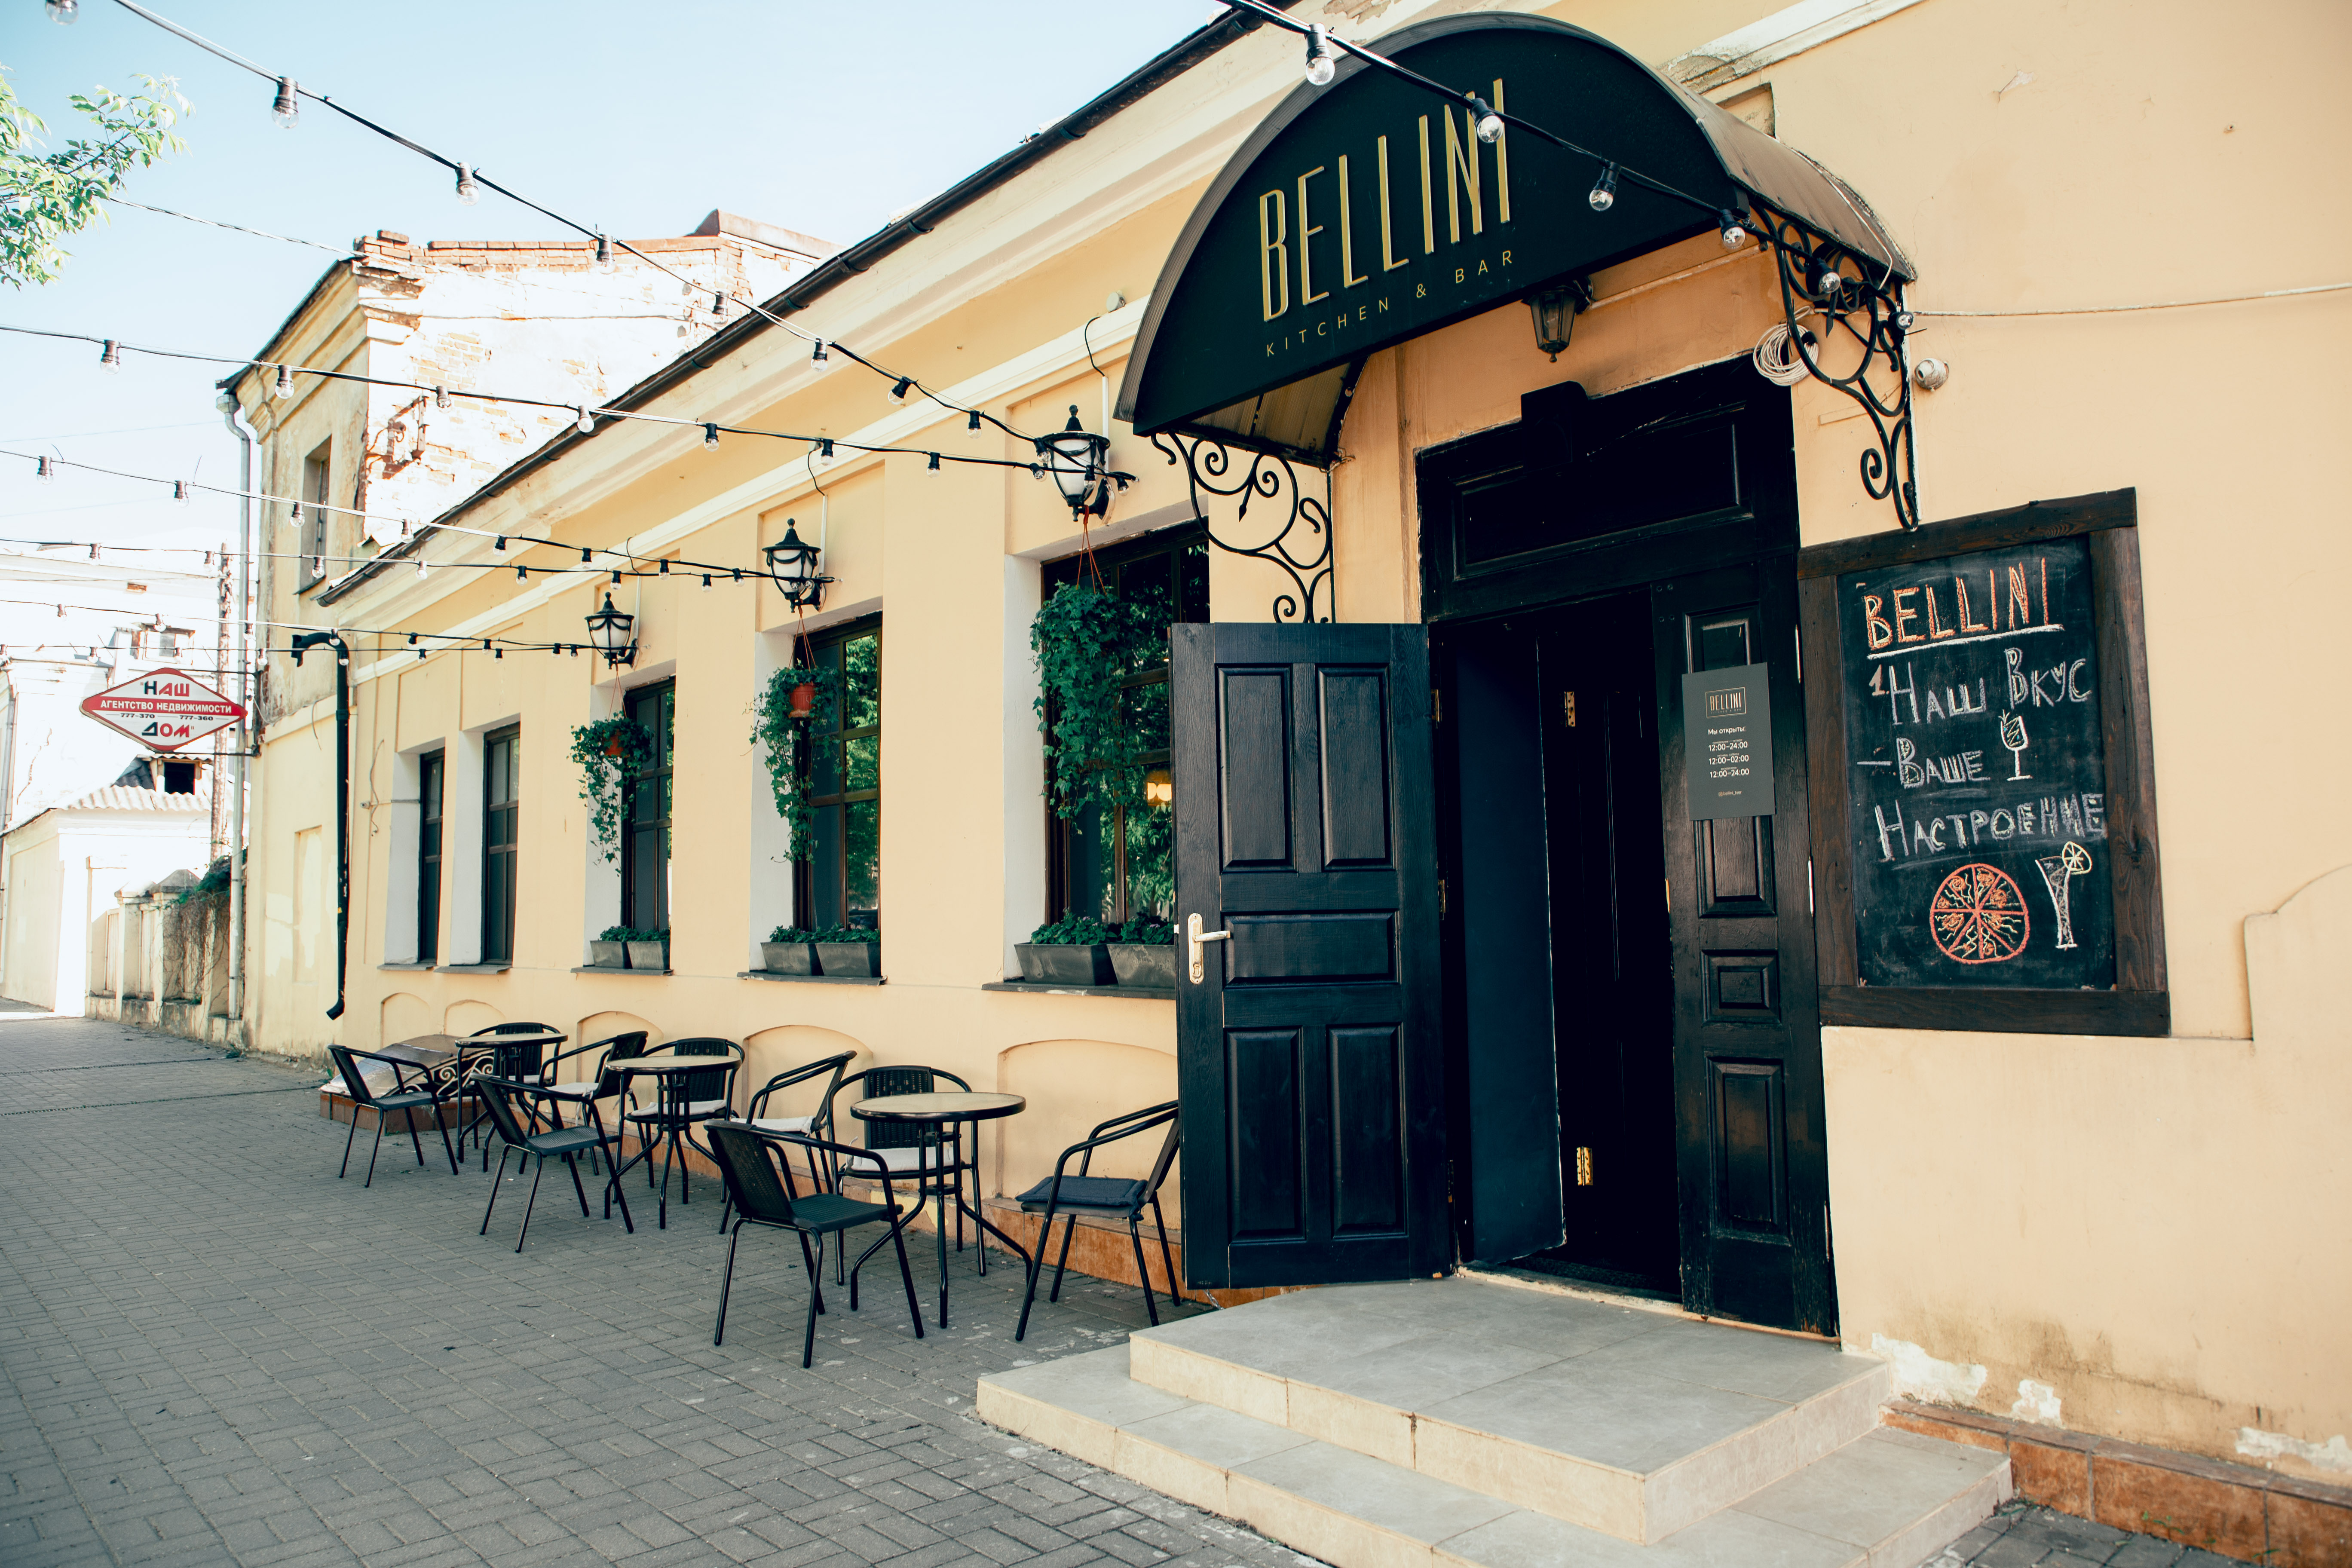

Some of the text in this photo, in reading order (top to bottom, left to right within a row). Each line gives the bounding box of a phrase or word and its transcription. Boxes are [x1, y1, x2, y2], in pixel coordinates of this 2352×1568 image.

[1259, 78, 1510, 322] BELLINI
[1266, 250, 1513, 357] KITCHEN & BAR
[1864, 557, 2049, 651] BELLINI
[101, 700, 232, 714] АГЕНТСТВО НЕДВИЖИМОСТИ
[1710, 692, 1741, 711] BELLINI
[1719, 726, 1746, 735] открыты:
